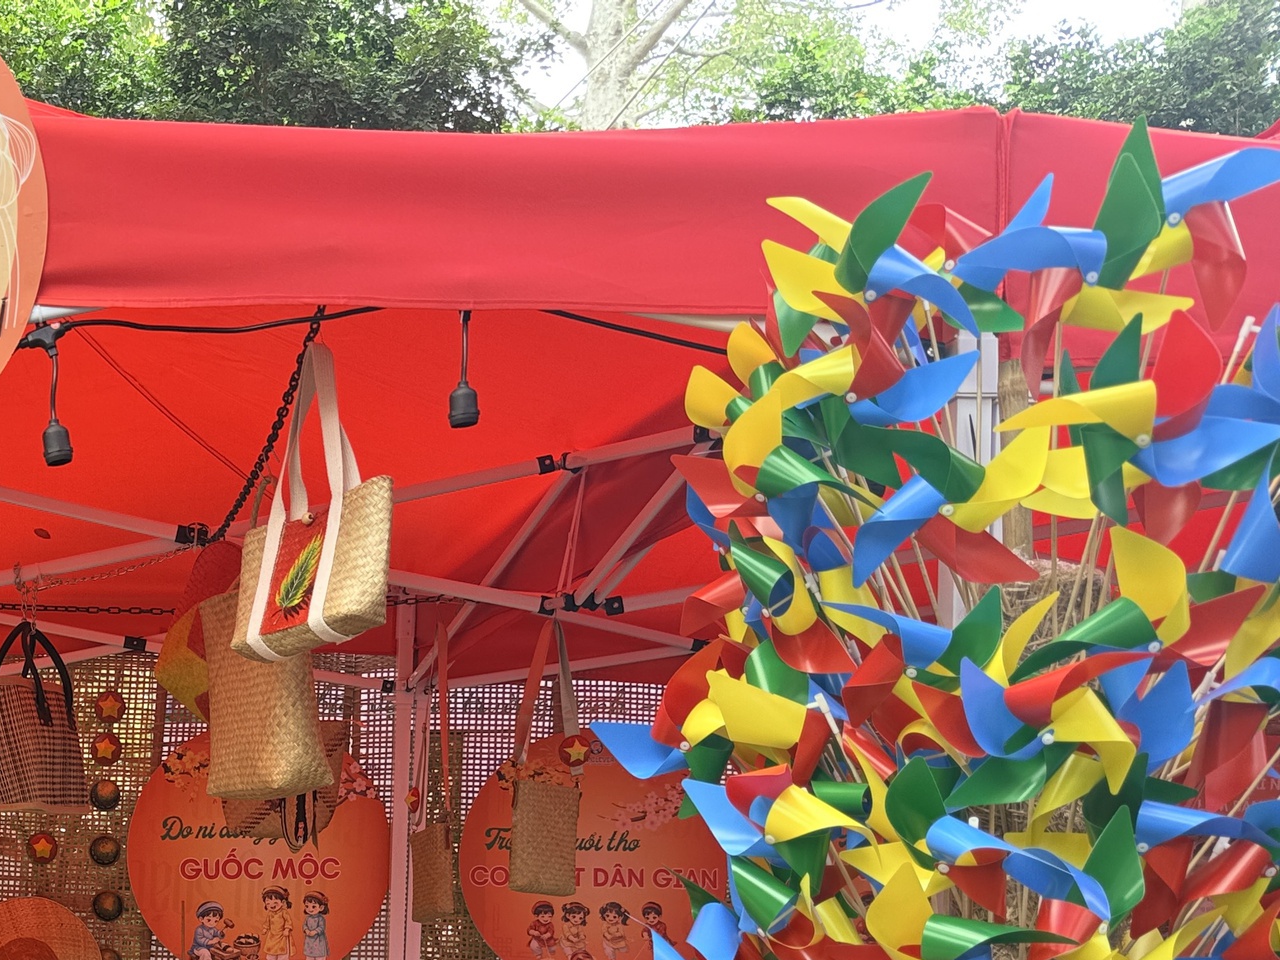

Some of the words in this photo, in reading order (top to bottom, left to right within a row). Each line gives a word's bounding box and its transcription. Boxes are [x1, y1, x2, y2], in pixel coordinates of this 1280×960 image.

[179, 847, 264, 881] GUỐC
[272, 853, 341, 885] MỘC
[592, 864, 644, 888] DÂN
